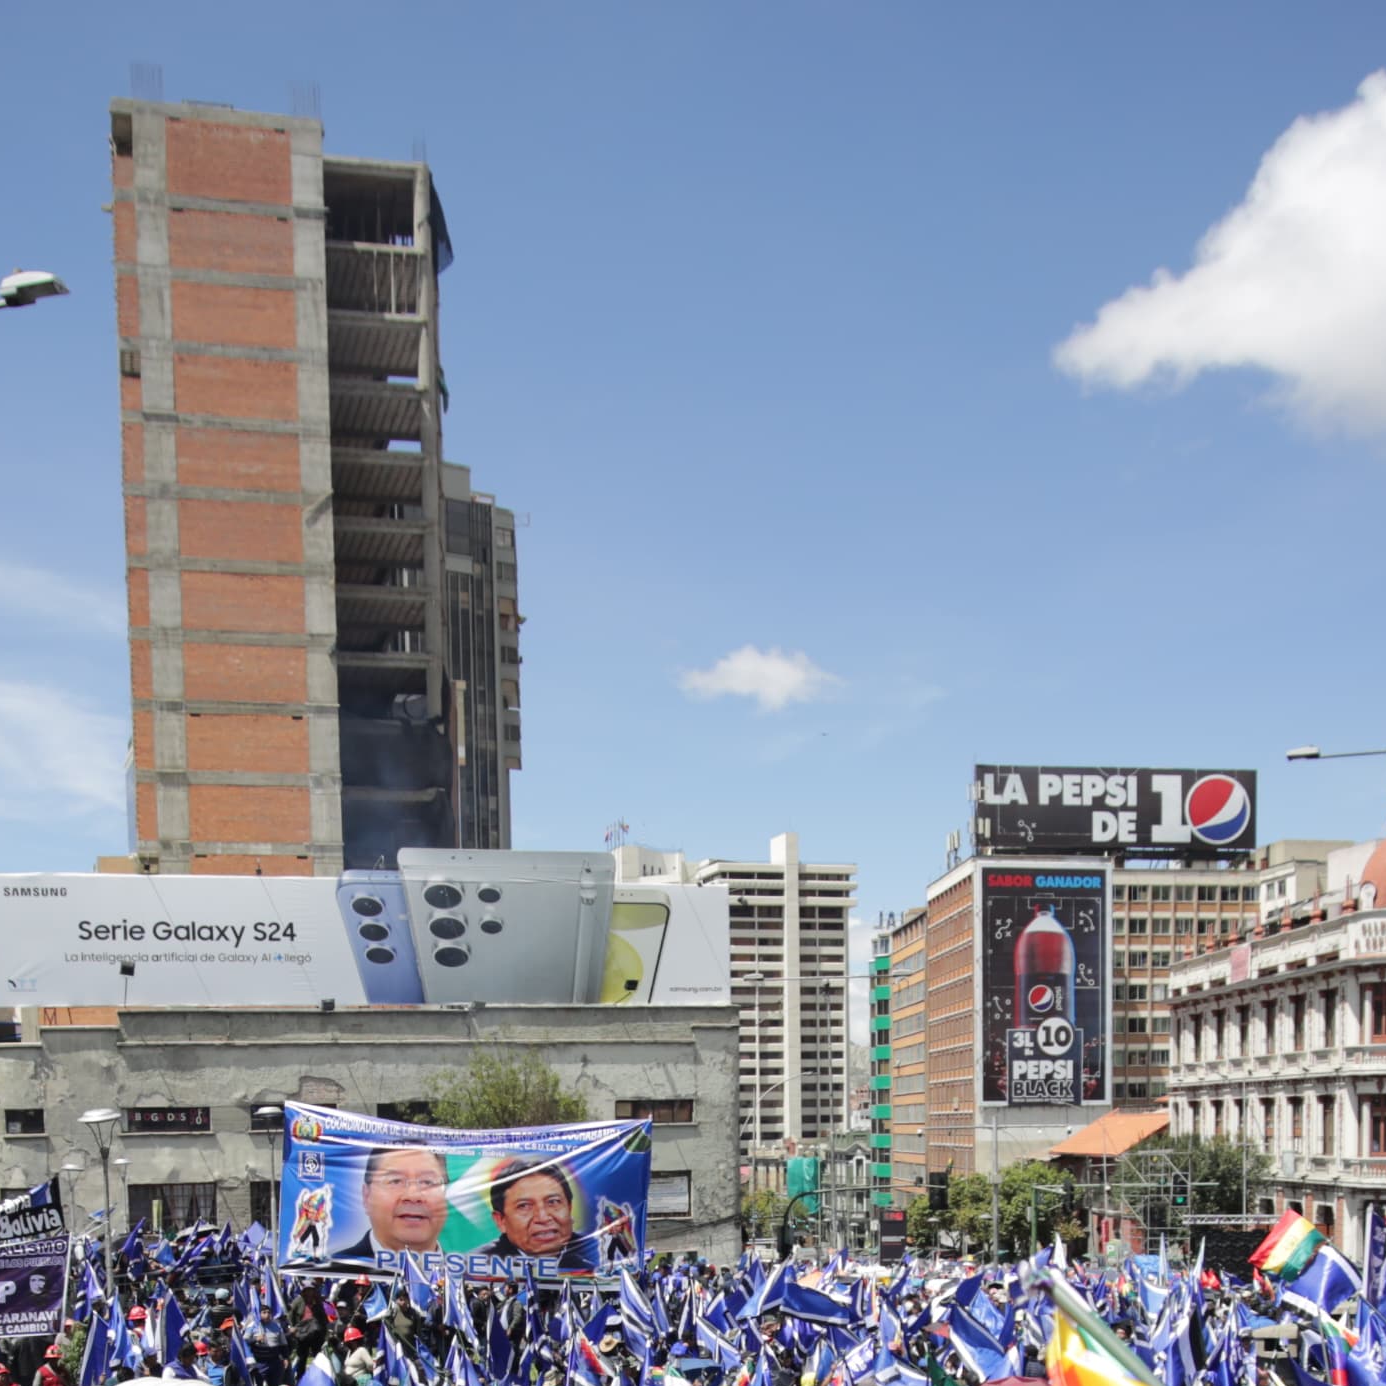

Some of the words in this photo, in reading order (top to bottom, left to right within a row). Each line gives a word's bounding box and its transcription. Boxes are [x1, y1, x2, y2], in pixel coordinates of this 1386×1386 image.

[984, 773, 1029, 805] LA
[1038, 774, 1138, 806] PEPSI
[1092, 811, 1138, 843] DE
[987, 874, 1032, 887] SABOR
[1035, 876, 1101, 889] GANADOR
[3, 887, 67, 897] SAMSUNG
[78, 919, 145, 942] Serie
[152, 921, 246, 948] Galaxy
[253, 922, 297, 942] S24
[64, 952, 78, 962] La
[151, 952, 198, 962] artificial
[200, 952, 215, 962] de
[218, 952, 258, 965] Galaxy
[1013, 1031, 1034, 1048] 3L
[1042, 1025, 1072, 1047] 10
[1013, 1060, 1075, 1080] PEPSI
[1013, 1079, 1075, 1099] BLACK
[325, 1116, 389, 1135] COORDINADORA
[5, 1258, 22, 1269] LOS
[23, 1255, 64, 1268] PUEBLOS
[376, 1249, 560, 1278] PRESENTE
[5, 1323, 49, 1334] CAMBIO
